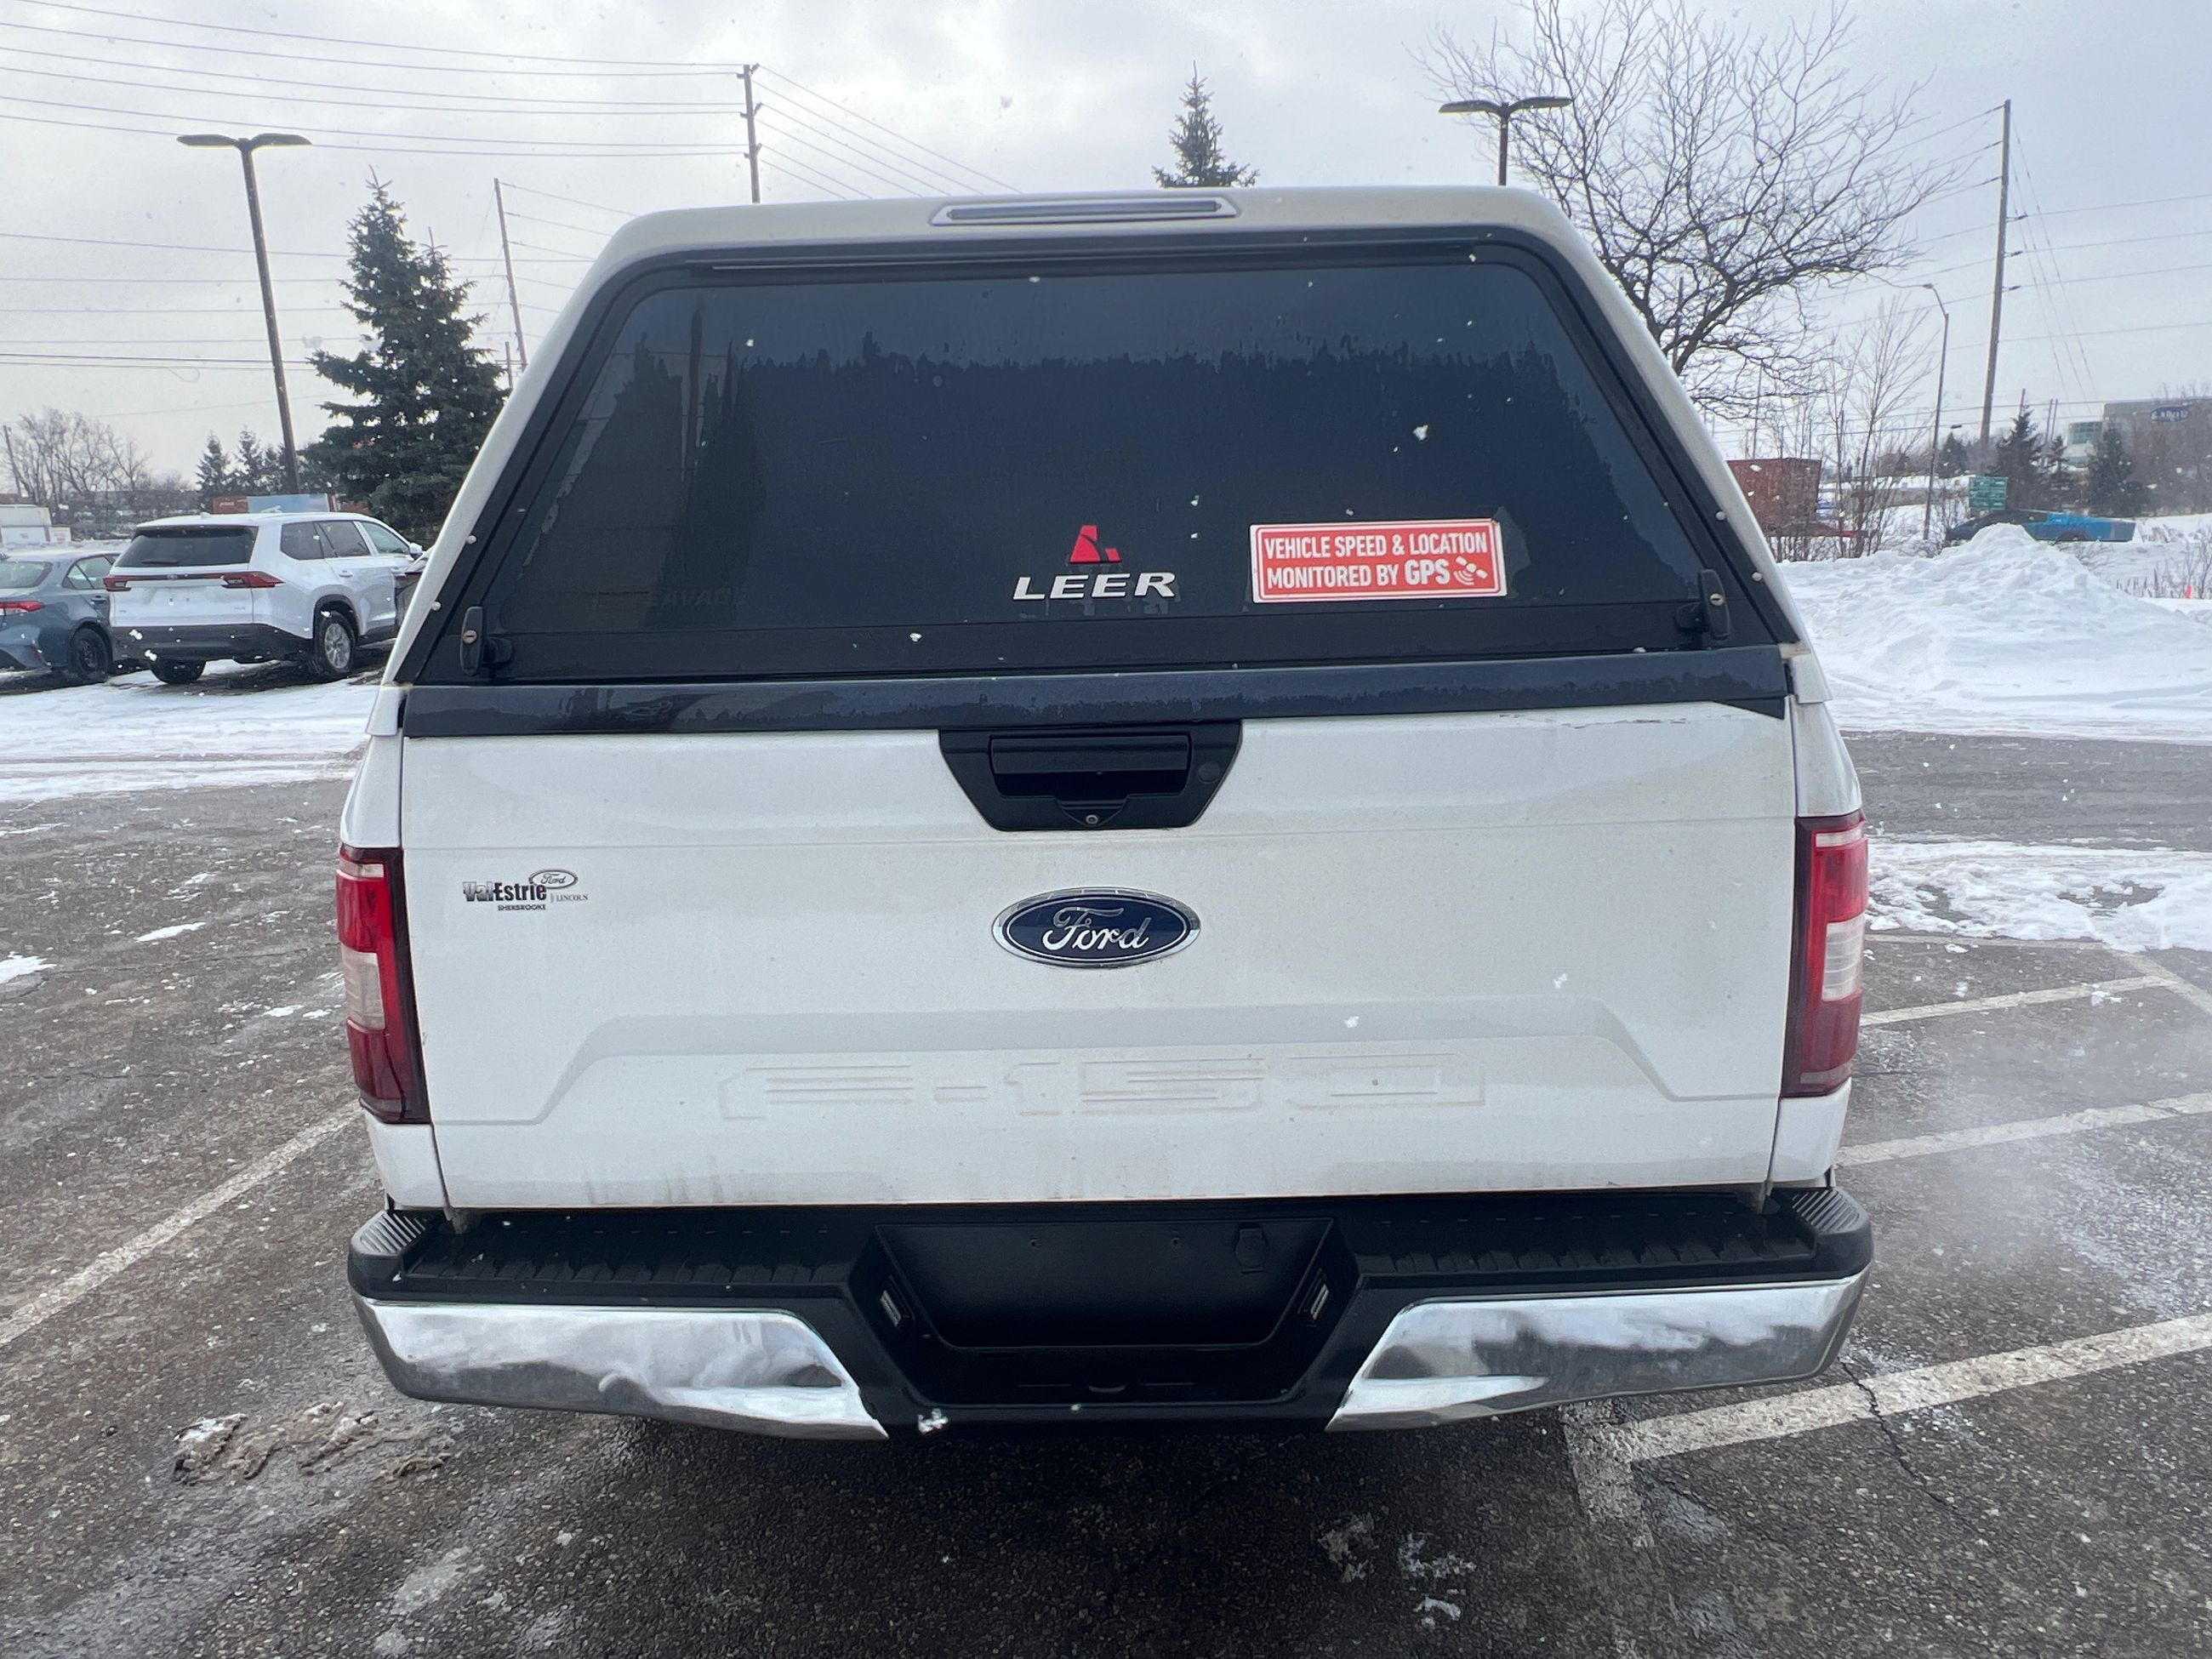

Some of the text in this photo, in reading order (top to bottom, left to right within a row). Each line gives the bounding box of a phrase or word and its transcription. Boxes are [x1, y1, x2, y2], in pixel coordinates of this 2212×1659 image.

[1264, 532, 1488, 559] VEHICLE SPEED & LOCATION
[1012, 573, 1176, 601] LEER
[1267, 559, 1451, 589] MONITORED BY GPS
[556, 893, 590, 903] LINCOLN
[1042, 906, 1152, 951] Ford
[717, 1052, 1486, 1120] F-150
